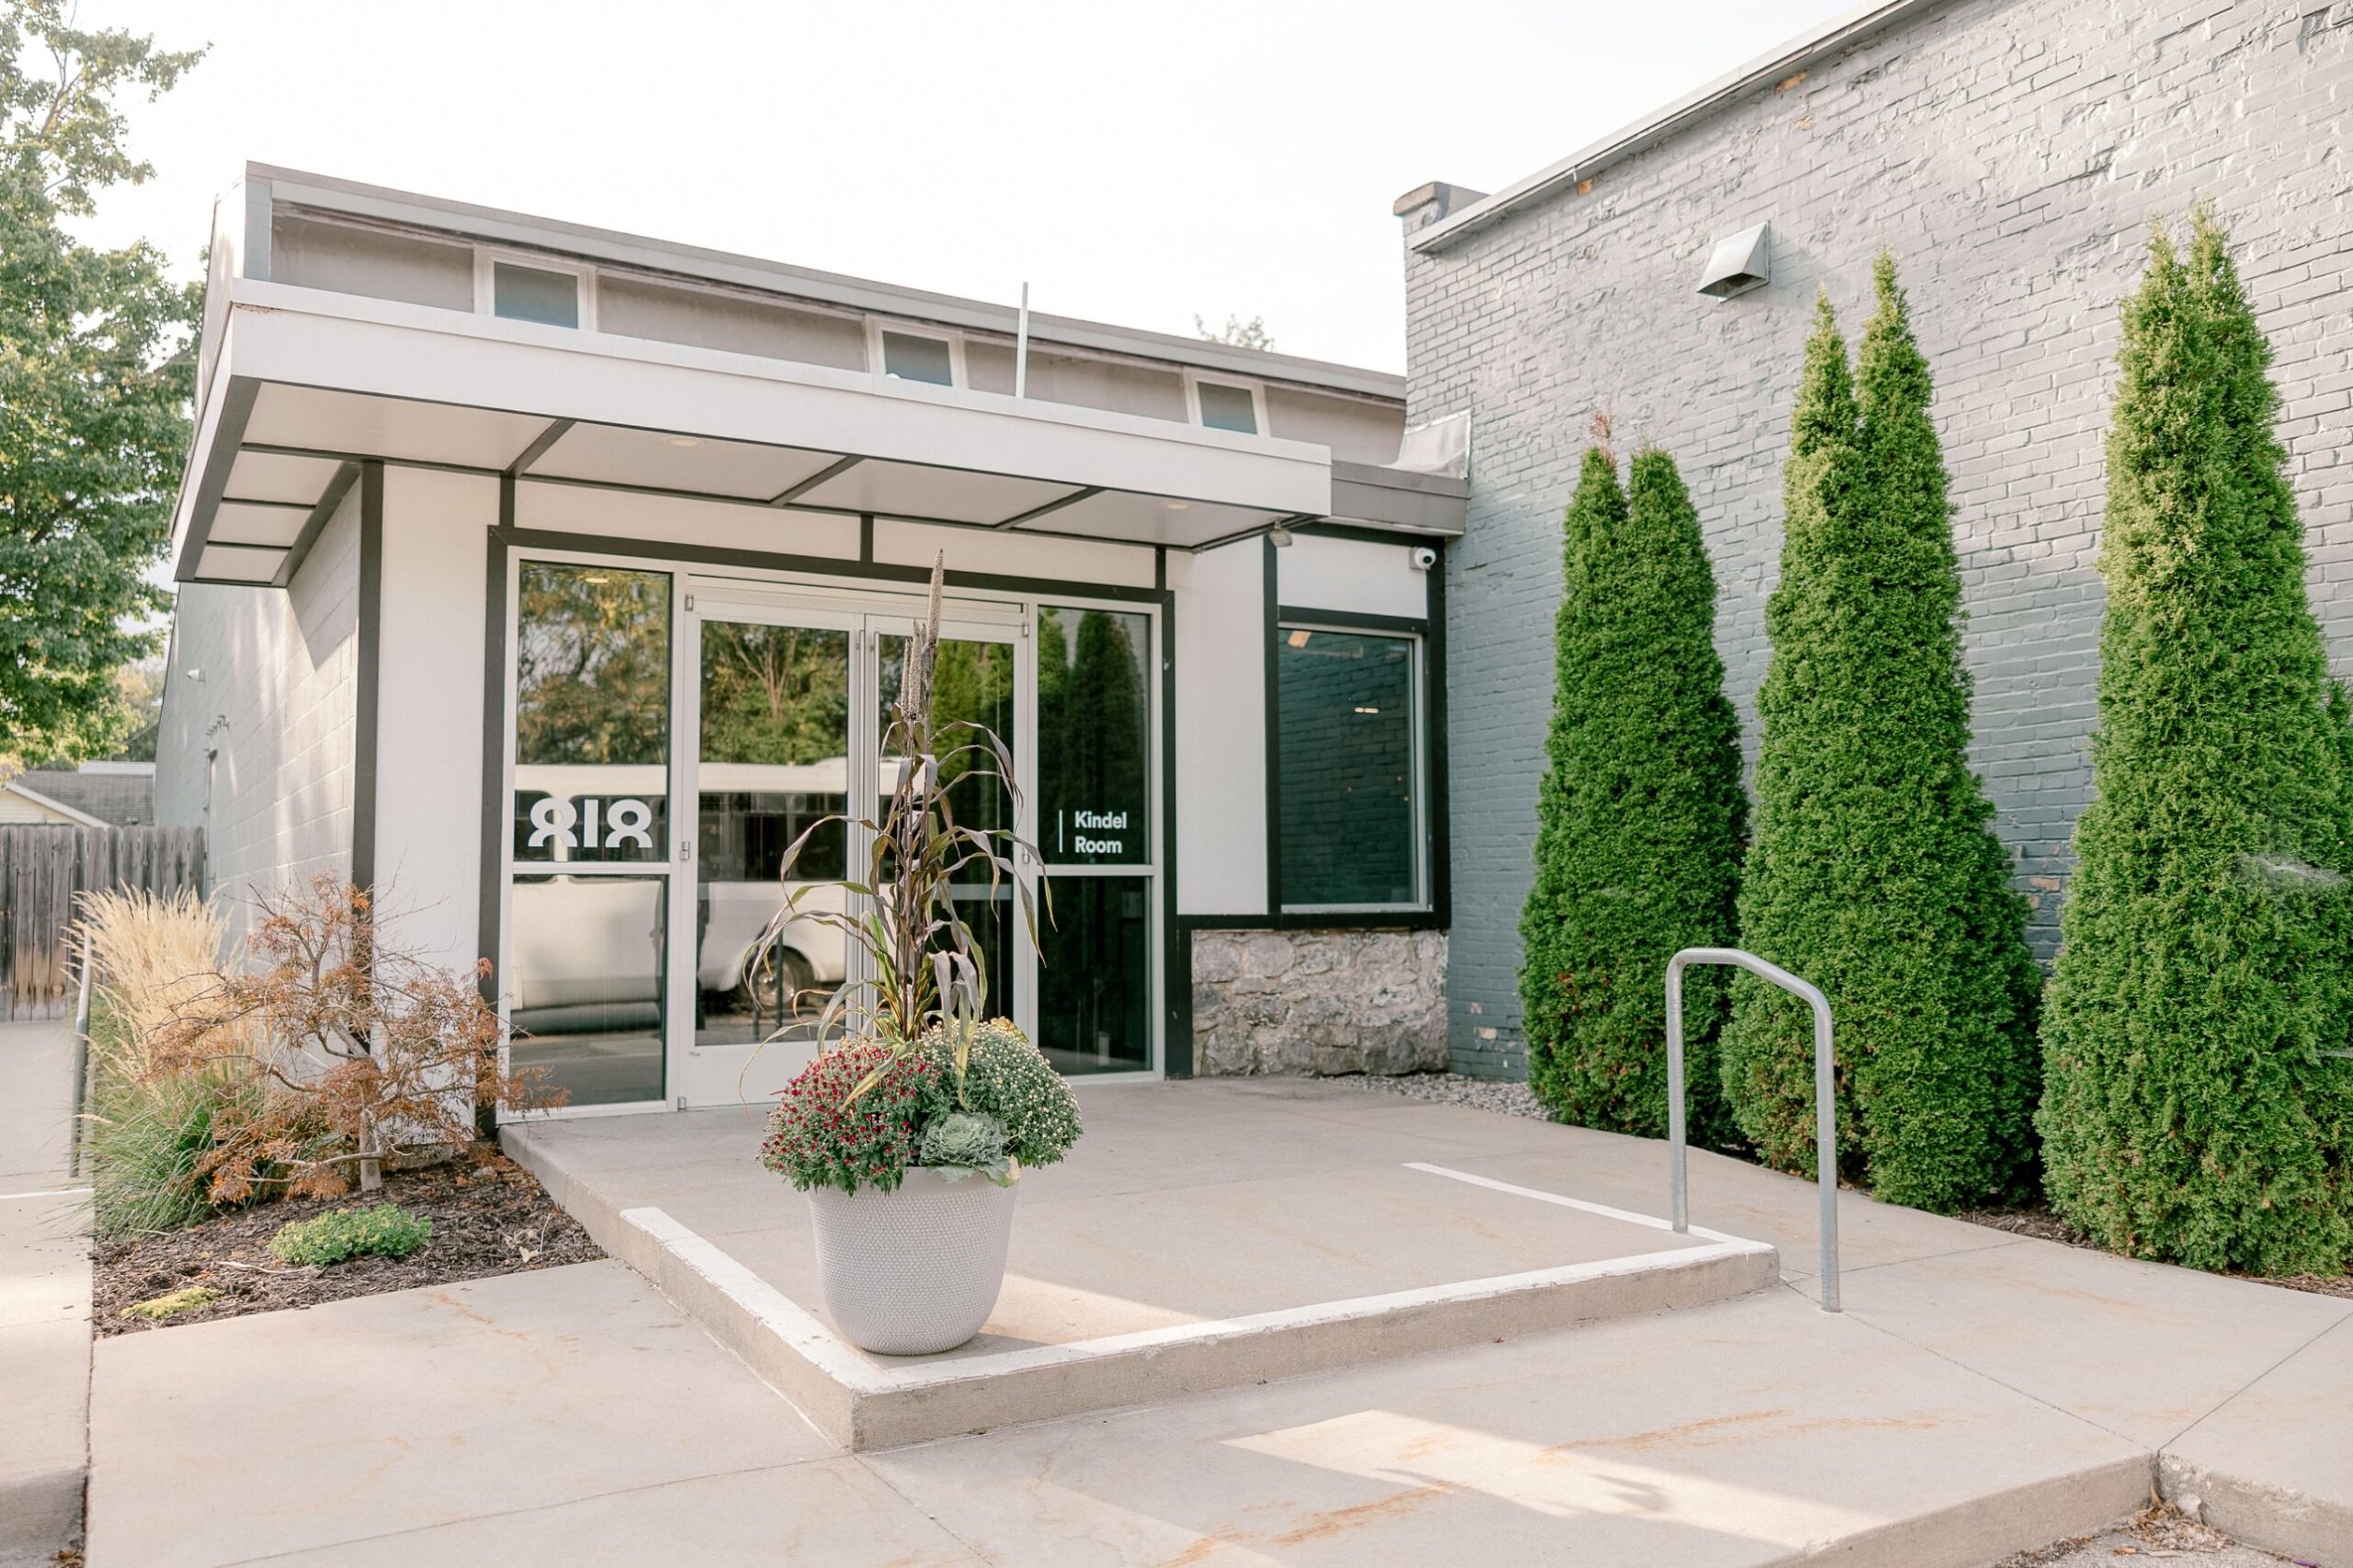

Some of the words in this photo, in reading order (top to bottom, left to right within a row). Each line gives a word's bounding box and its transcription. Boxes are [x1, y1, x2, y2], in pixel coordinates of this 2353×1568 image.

[528, 797, 654, 848] 818
[1074, 811, 1128, 829] Kindel
[1074, 835, 1123, 854] Room
